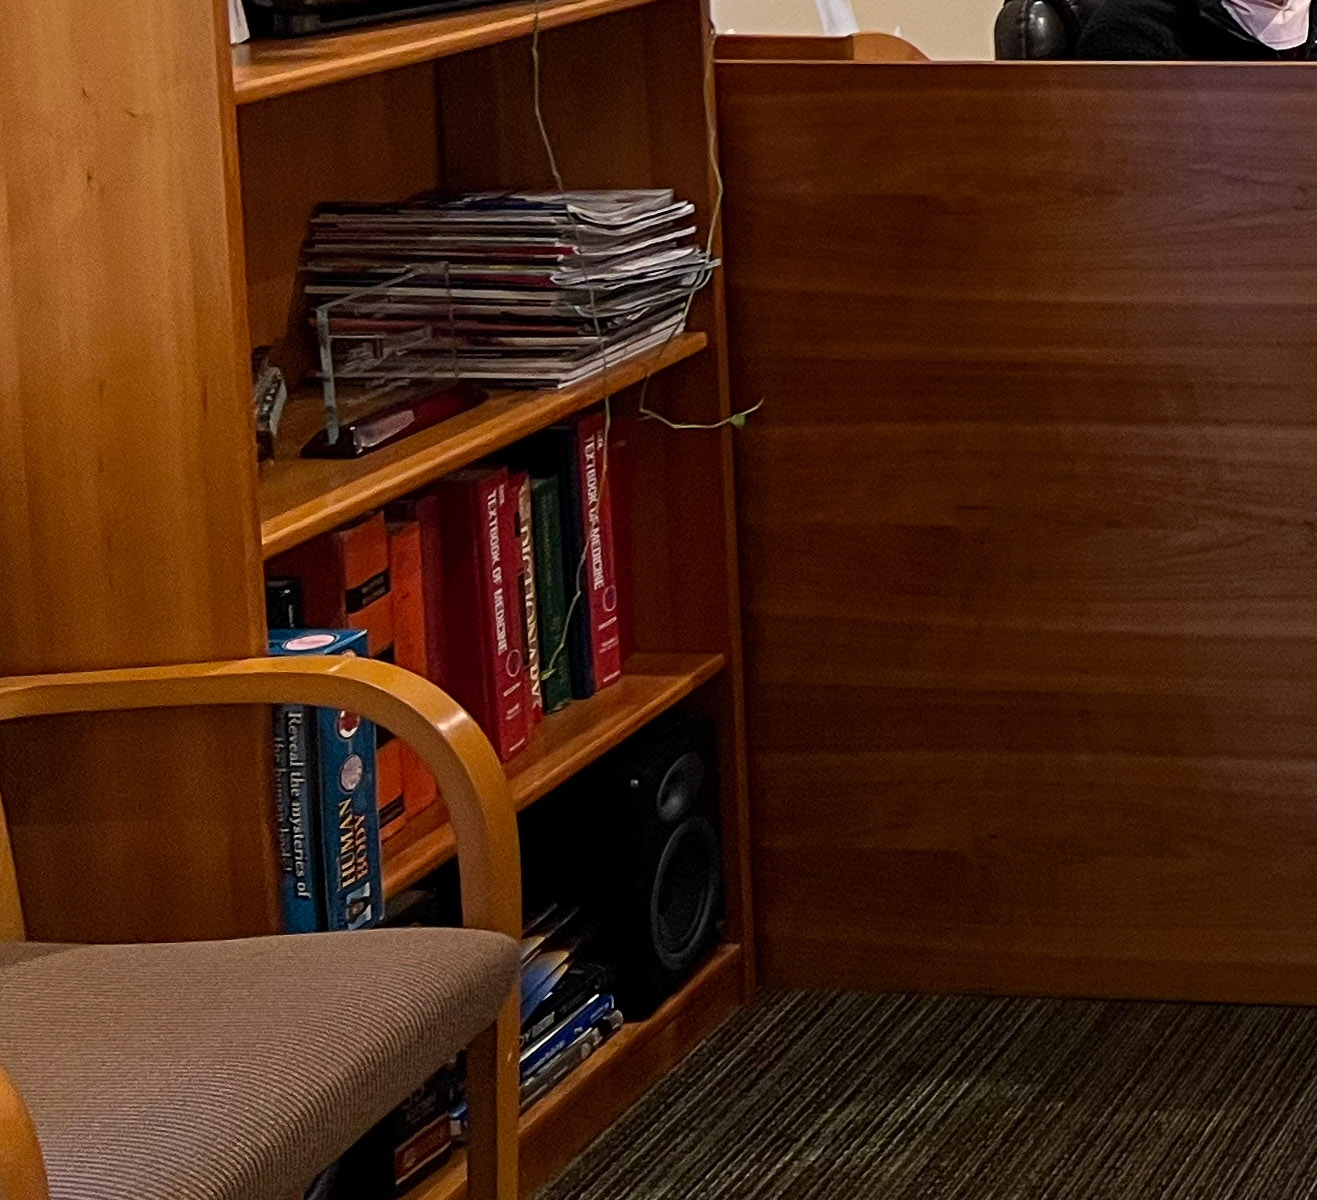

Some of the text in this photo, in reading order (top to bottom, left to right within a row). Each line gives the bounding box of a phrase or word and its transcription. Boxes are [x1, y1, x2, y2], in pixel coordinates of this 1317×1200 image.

[584, 434, 600, 505] TEXTBOOK
[486, 488, 509, 657] TEXTBOOK OF MEDICINE
[590, 526, 605, 591] MEDICINE
[287, 712, 312, 899] Reveal the mysteries of
[338, 797, 357, 889] HUMAN
[354, 814, 369, 880] BODY
